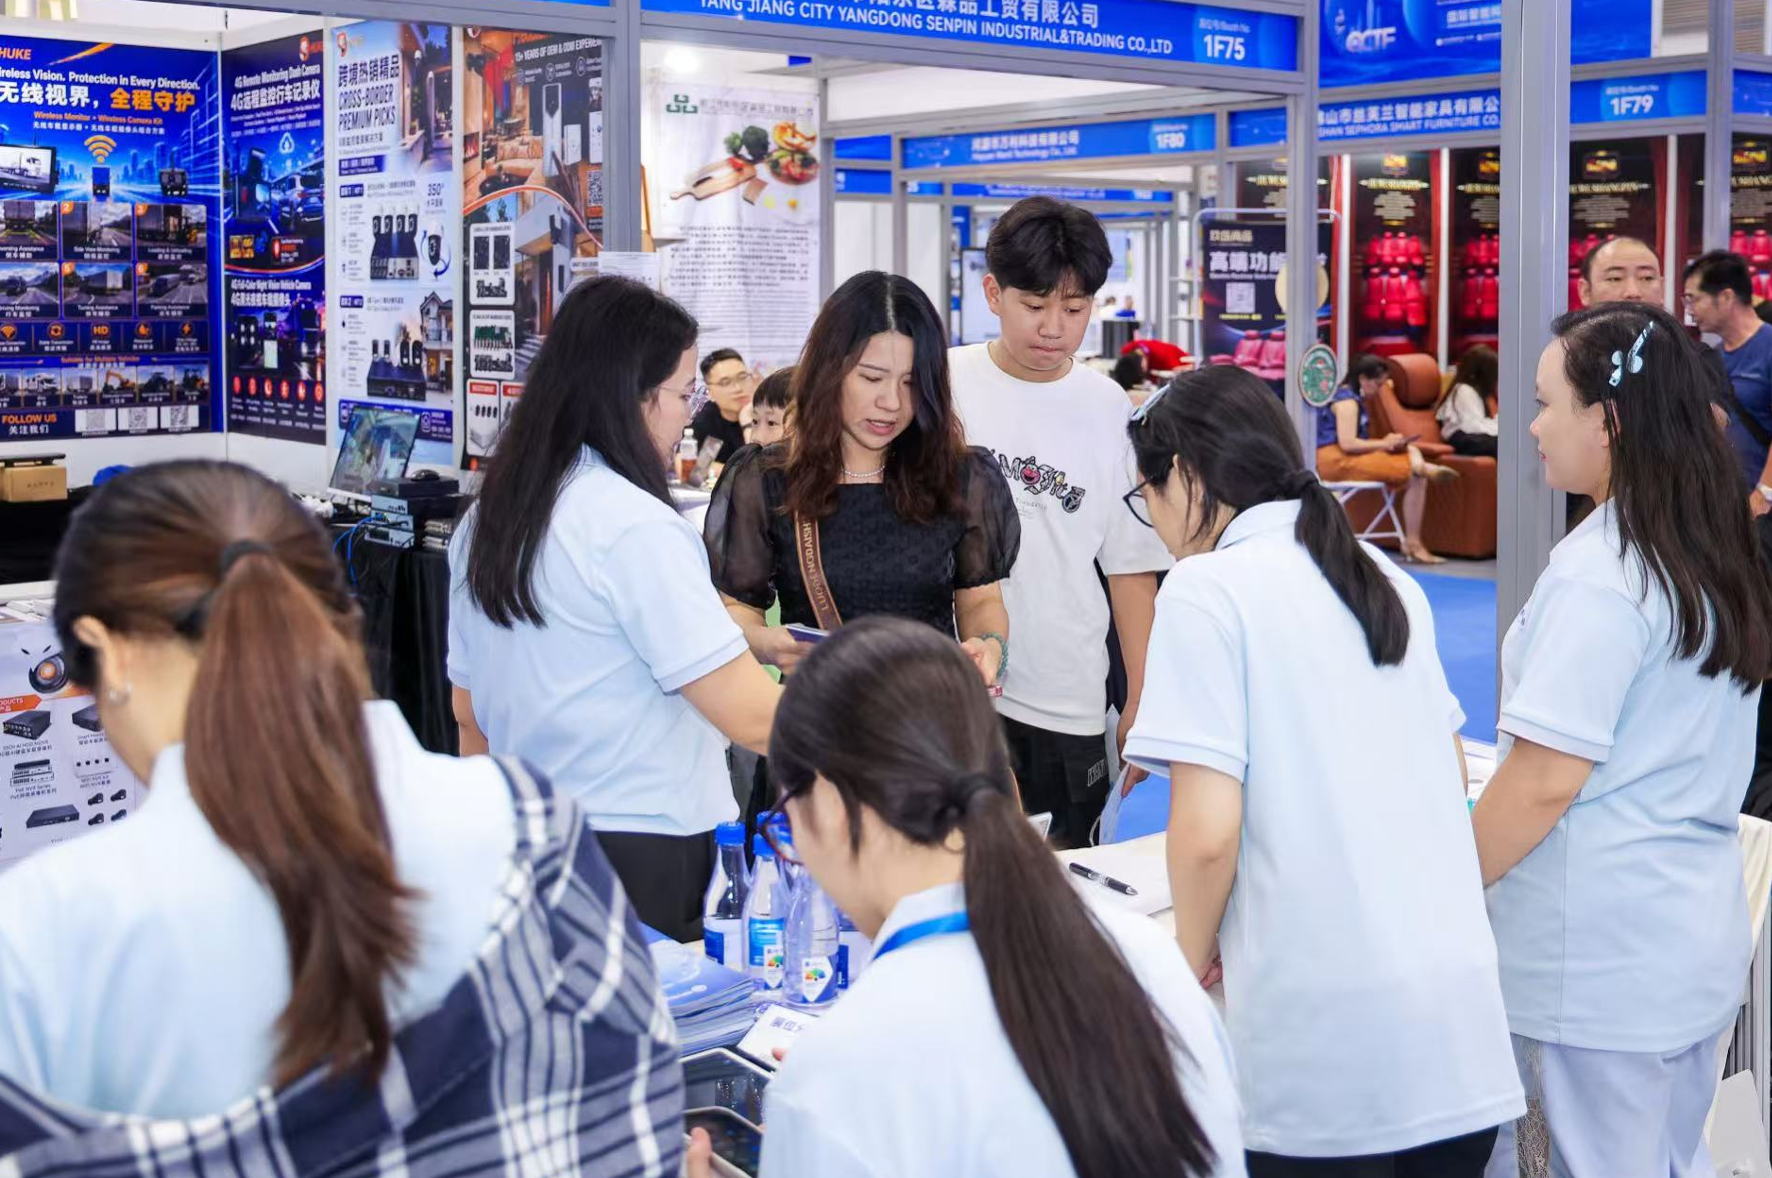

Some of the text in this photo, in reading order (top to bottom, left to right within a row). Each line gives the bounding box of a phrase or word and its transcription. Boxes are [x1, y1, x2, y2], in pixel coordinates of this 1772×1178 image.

[747, 1, 795, 16] JIANG
[799, 2, 834, 20] CITY
[837, 6, 922, 29] YANGDONG
[926, 15, 977, 35] SENPIN
[981, 20, 1125, 49] INDUSTRIAL&TRADING
[868, 0, 1099, 29] 森品工贸有限公司
[524, 49, 540, 60] YEARS
[540, 47, 547, 57] OF
[1203, 34, 1246, 60] 1F75
[33, 69, 65, 82] Vision.
[69, 71, 118, 86] Protection
[119, 74, 129, 86] in
[130, 75, 157, 90] Every
[157, 78, 201, 92] Direction.
[338, 54, 401, 87] 跨境热销精品
[230, 79, 321, 111] 4G远程监控行车记录仪
[338, 84, 395, 110] CROSS-BORDER
[1610, 94, 1655, 116] 1F79
[338, 109, 373, 131] PREMIUM
[374, 106, 396, 127] PICKS
[1390, 119, 1422, 132] SMART
[1424, 115, 1480, 129] FURNITURE
[93, 326, 109, 335] HD
[2, 413, 57, 424] FOLLOW US
[9, 424, 49, 435] 关注我们
